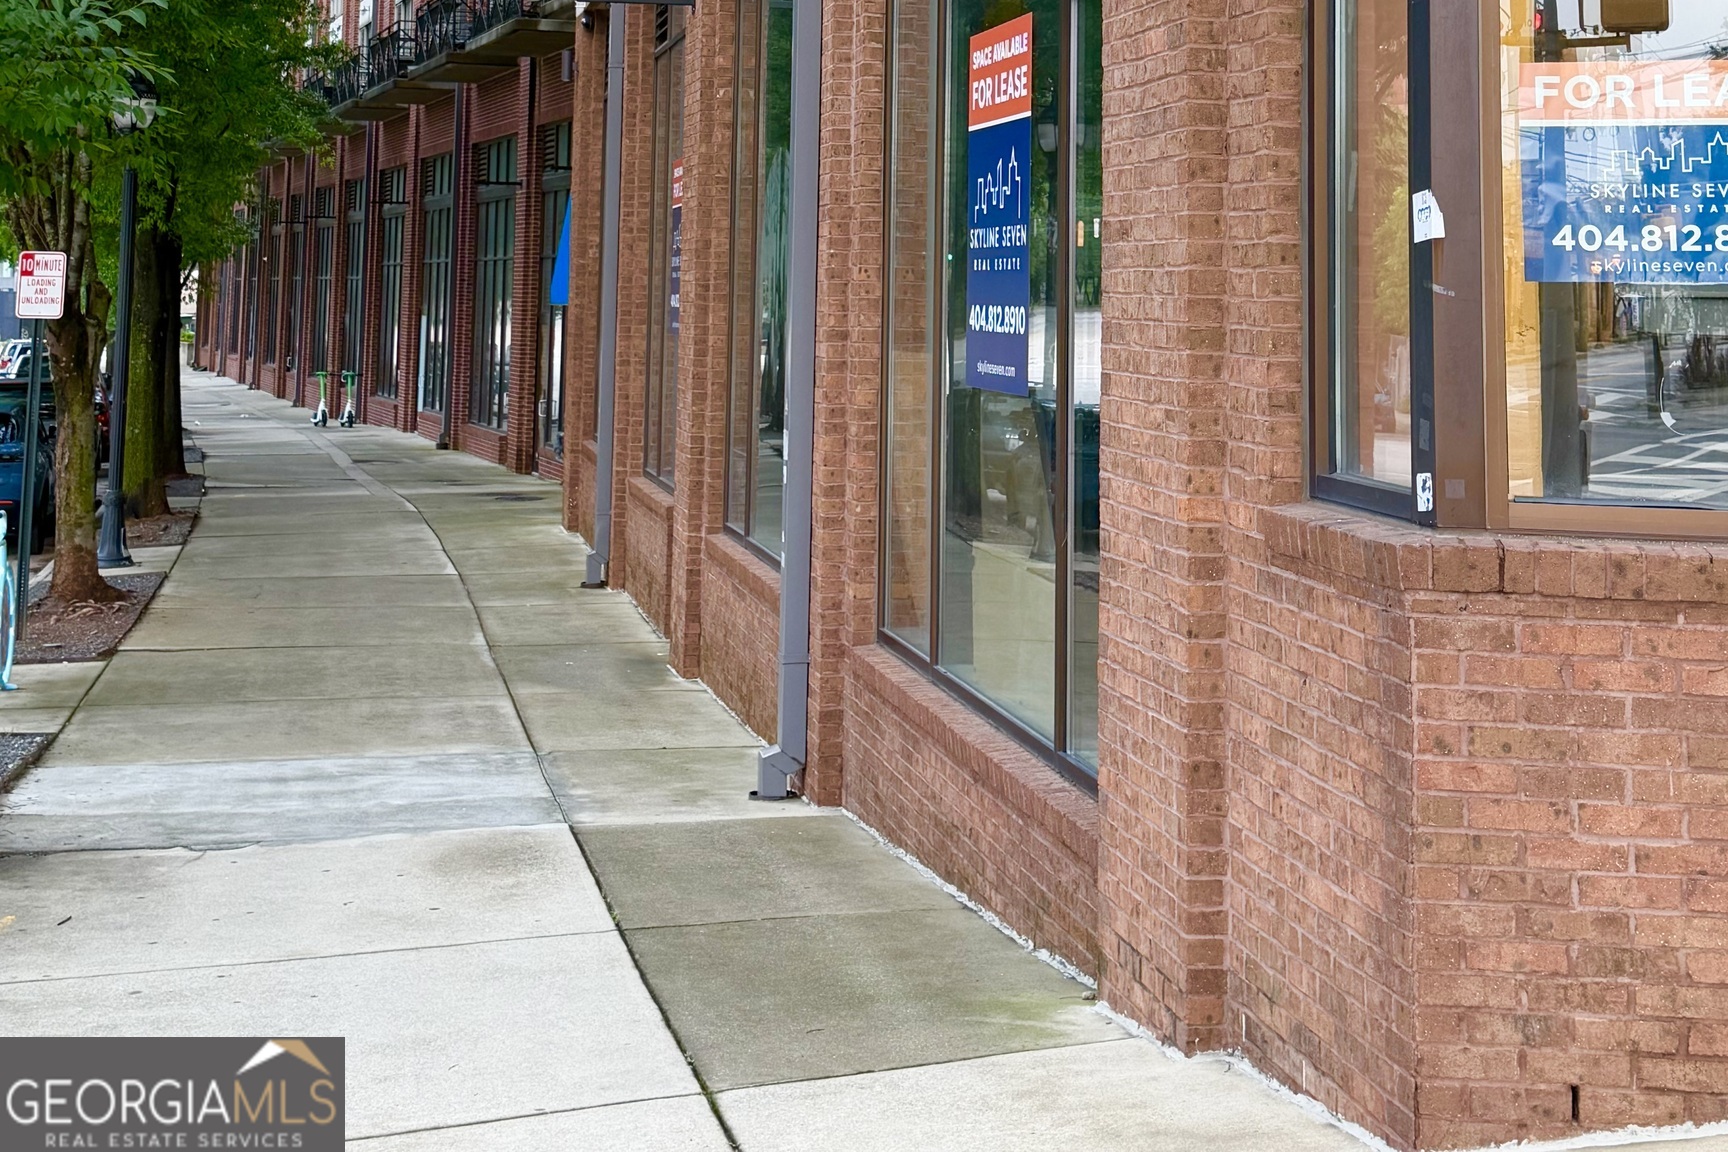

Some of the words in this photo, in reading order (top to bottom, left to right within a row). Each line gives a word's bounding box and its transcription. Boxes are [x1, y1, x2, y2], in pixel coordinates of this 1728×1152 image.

[972, 45, 993, 70] SPACE
[992, 32, 1028, 64] AVAILABLE
[972, 76, 993, 111] FOR
[994, 64, 1028, 105] LEASE
[1534, 74, 1636, 109] FOR
[1590, 183, 1680, 199] SKYLINE
[1604, 204, 1654, 214] REAL
[969, 226, 1000, 249] SKYLINE
[1001, 224, 1027, 247] SEVEN
[22, 259, 34, 272] 10
[35, 259, 62, 272] MINUTE
[973, 259, 990, 271] REAL
[994, 257, 1020, 271] ESTATE
[26, 279, 57, 287] LOADING
[34, 288, 48, 296] AND
[21, 296, 60, 305] UNLOADING
[969, 304, 1026, 335] 404.812.8910
[976, 359, 1016, 378] skylineseven.com
